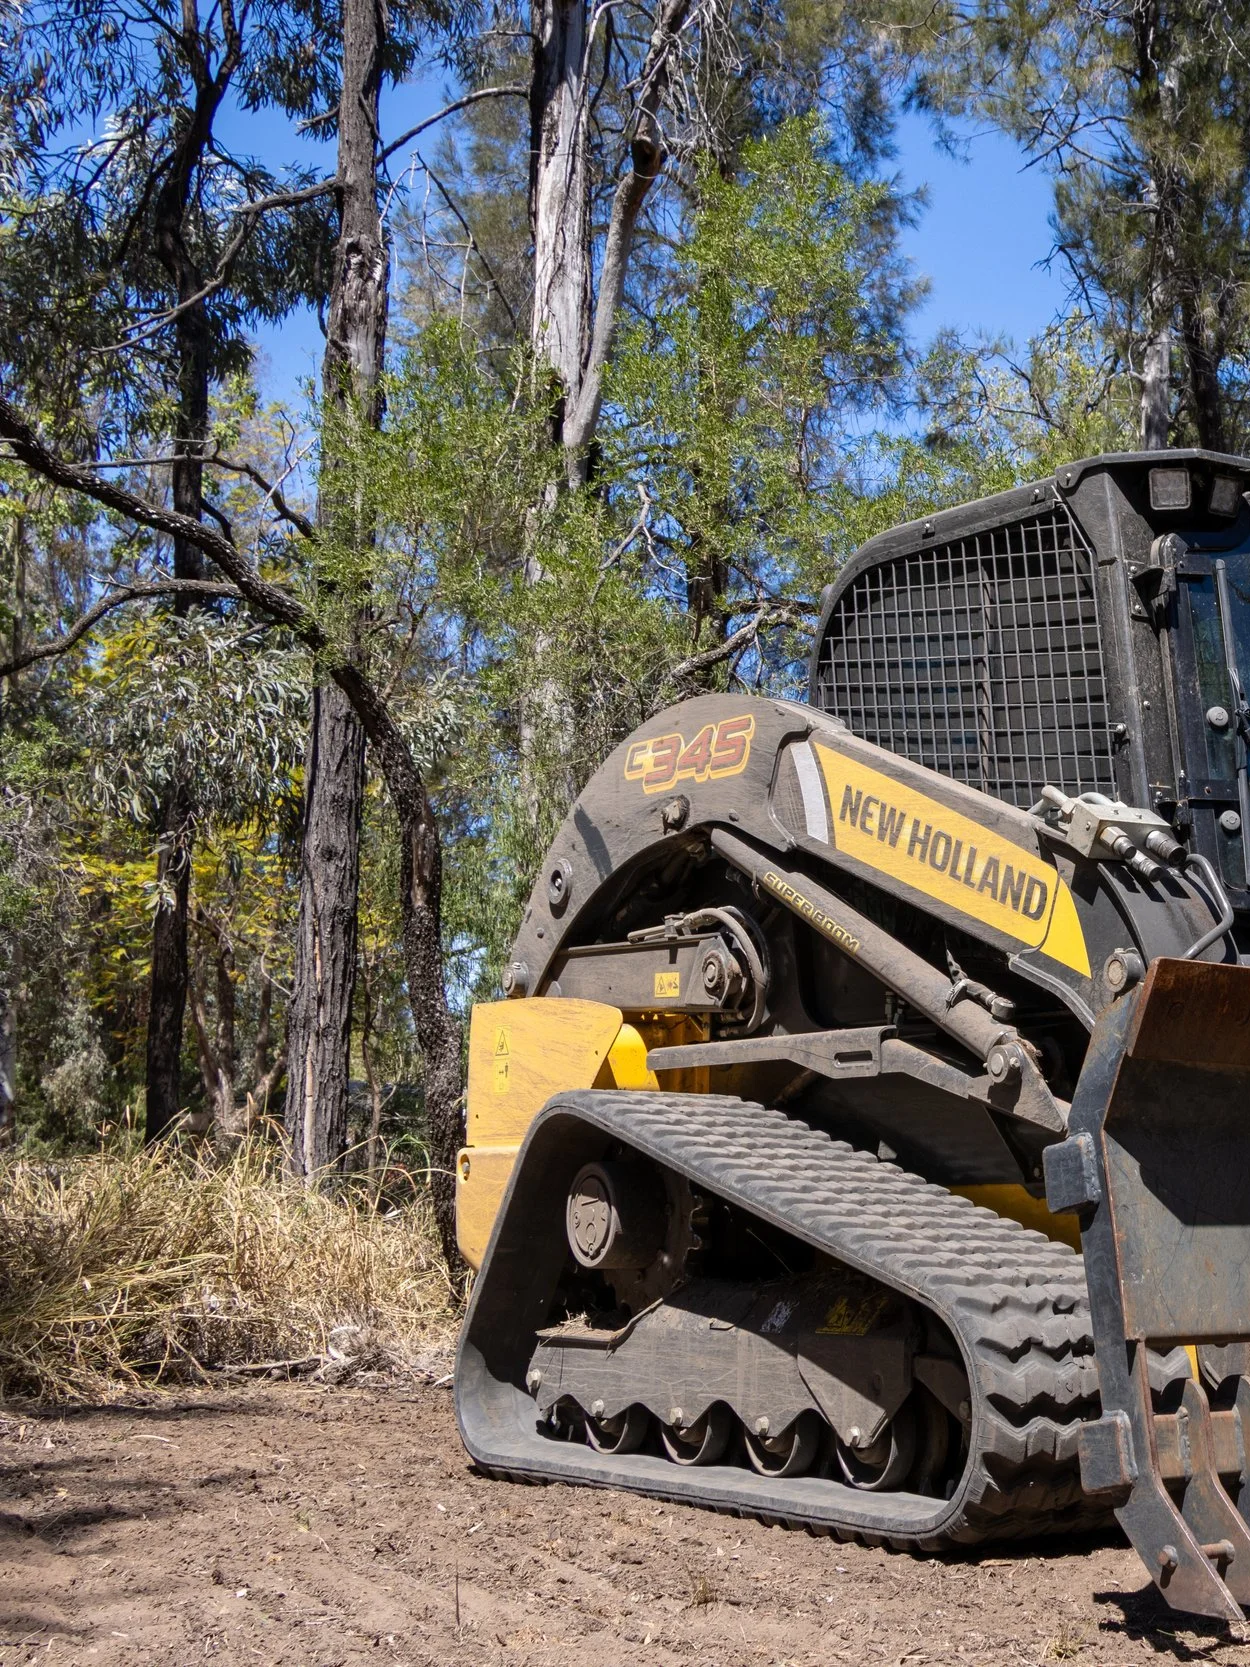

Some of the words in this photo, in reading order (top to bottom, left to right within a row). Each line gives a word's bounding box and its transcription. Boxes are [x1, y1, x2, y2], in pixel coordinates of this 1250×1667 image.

[624, 714, 755, 794] C345
[839, 784, 906, 848] NEW
[907, 818, 1048, 921] HOLLAND
